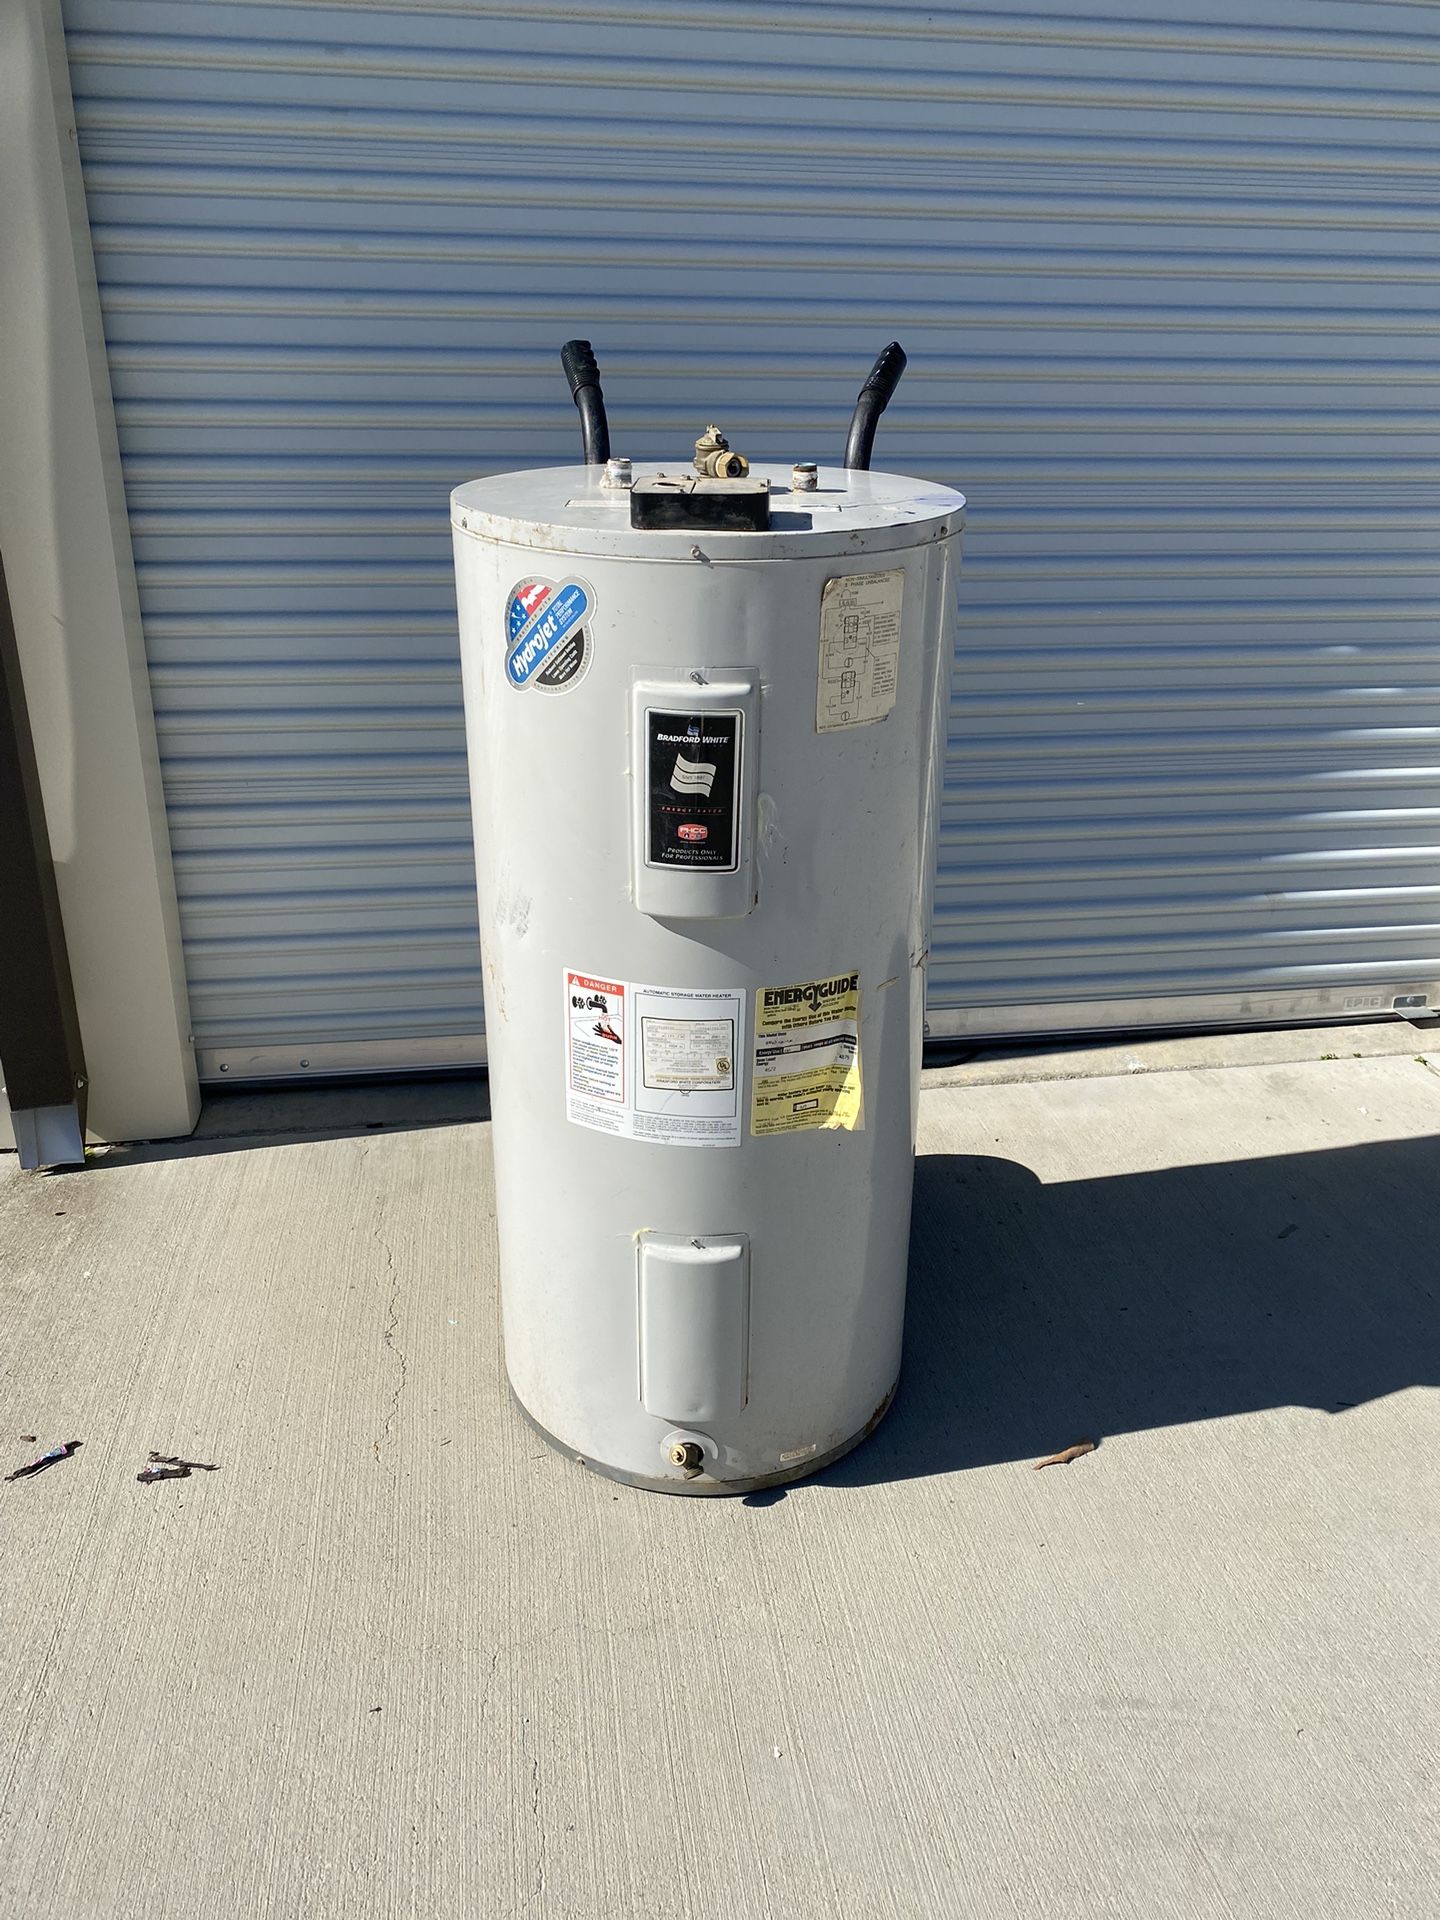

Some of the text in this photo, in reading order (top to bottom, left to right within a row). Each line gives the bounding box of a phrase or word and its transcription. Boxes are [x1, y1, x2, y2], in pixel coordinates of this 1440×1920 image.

[512, 614, 558, 678] Hydrojet
[657, 733, 728, 744] BRADFORD WHITE
[583, 979, 617, 992] DANGER
